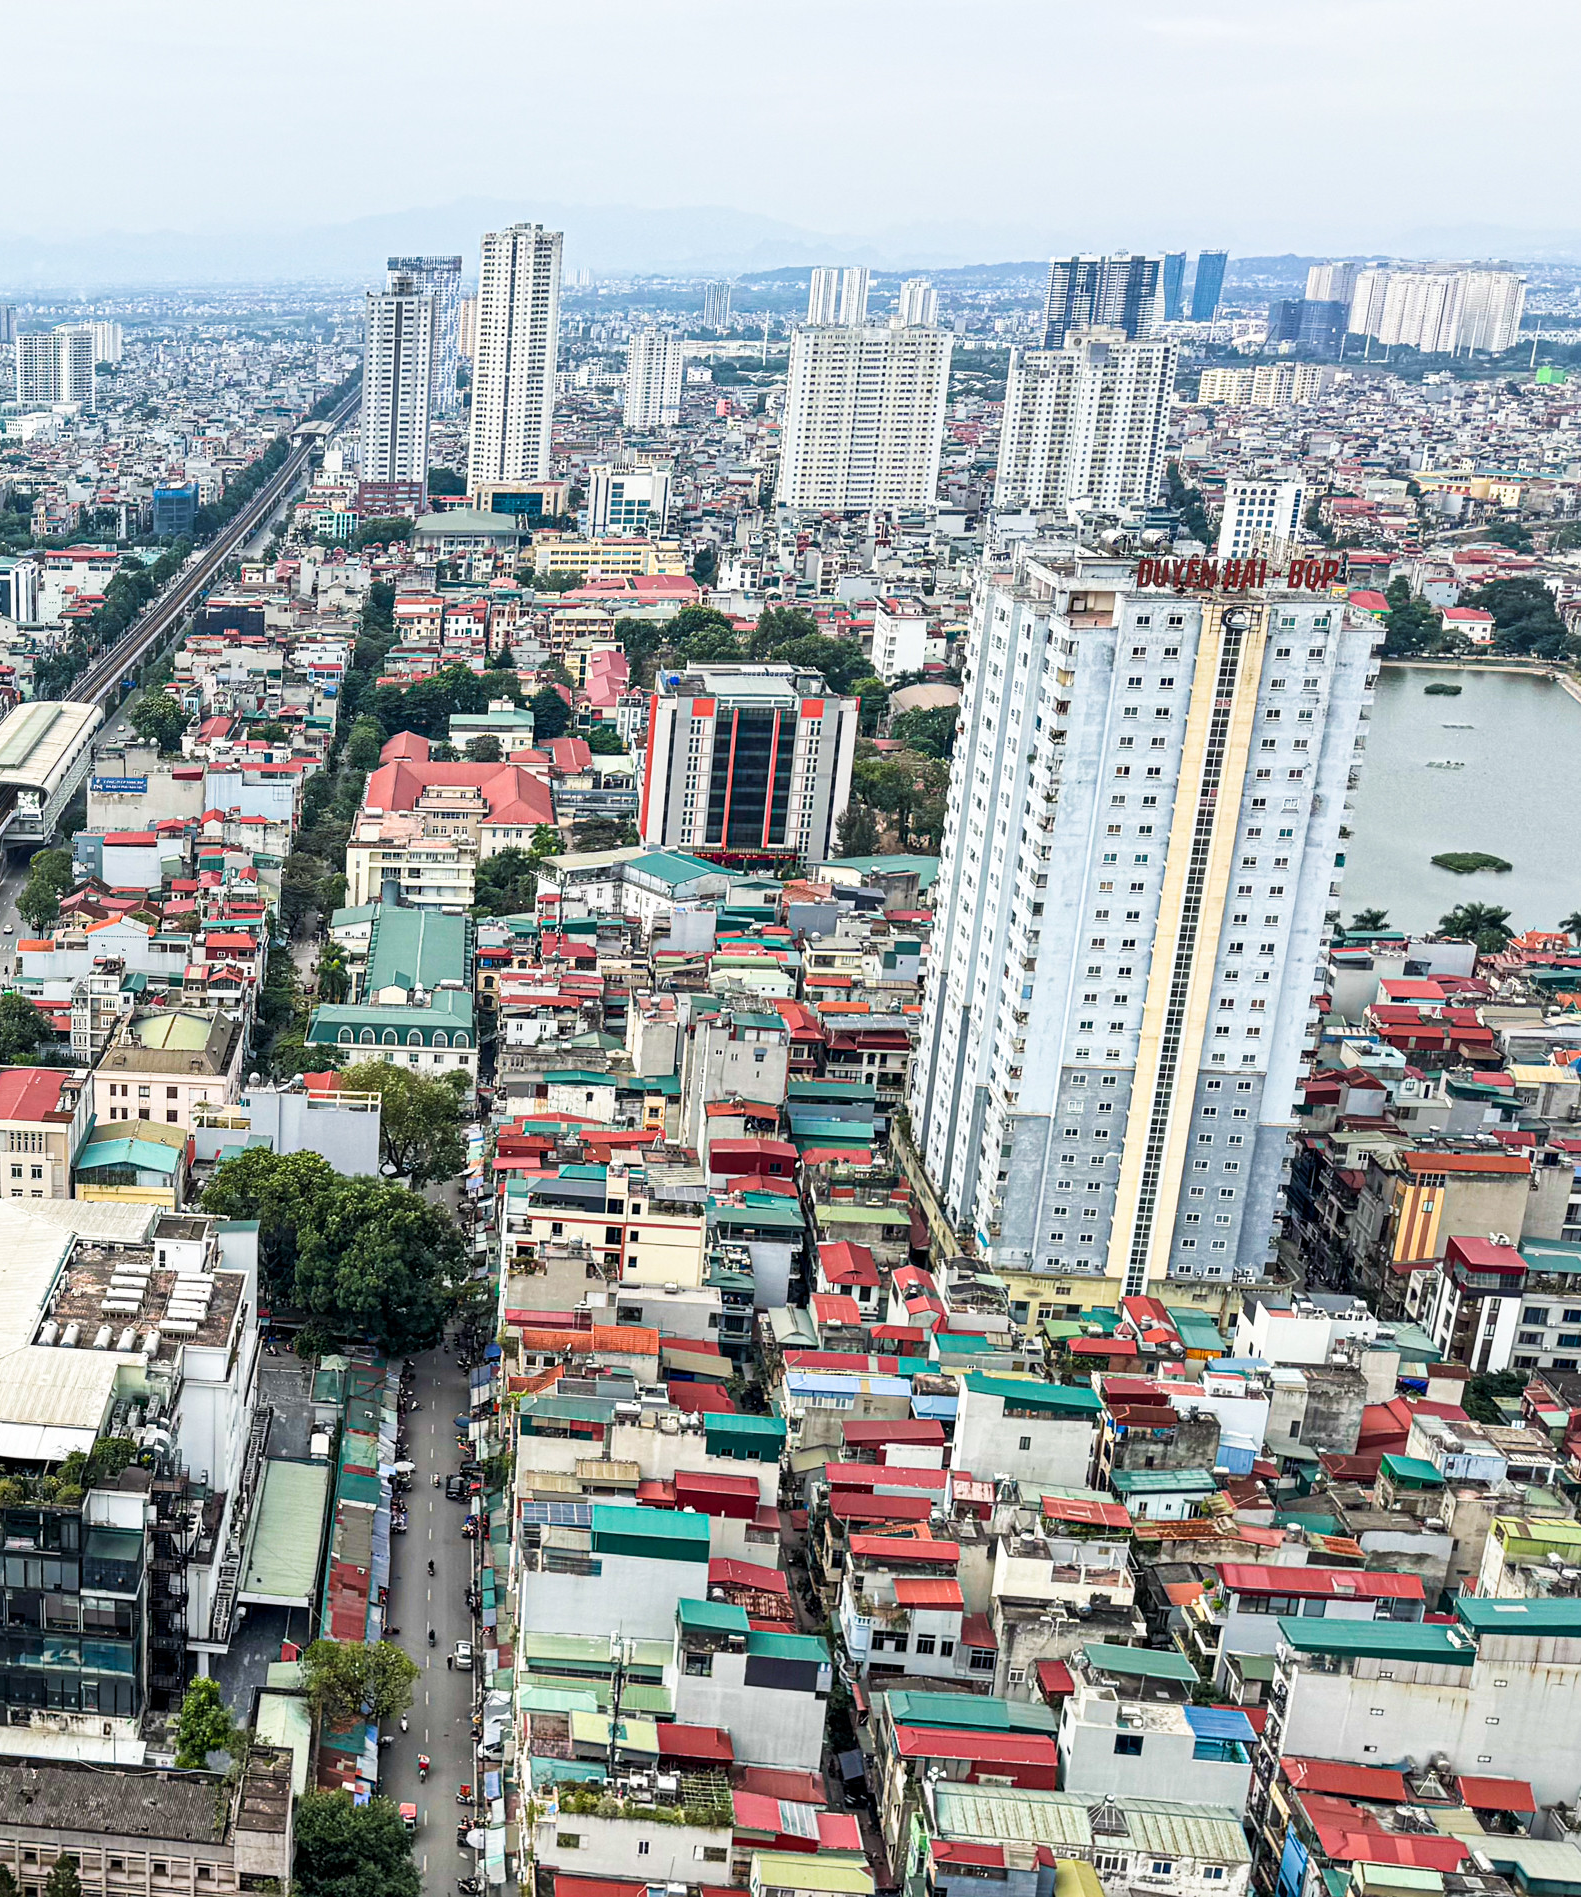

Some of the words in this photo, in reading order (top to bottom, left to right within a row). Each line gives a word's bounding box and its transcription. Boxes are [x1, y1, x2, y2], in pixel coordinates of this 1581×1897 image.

[1137, 553, 1219, 588] DUYÊN
[1223, 548, 1269, 589] HẢI
[1287, 559, 1339, 592] BQP
